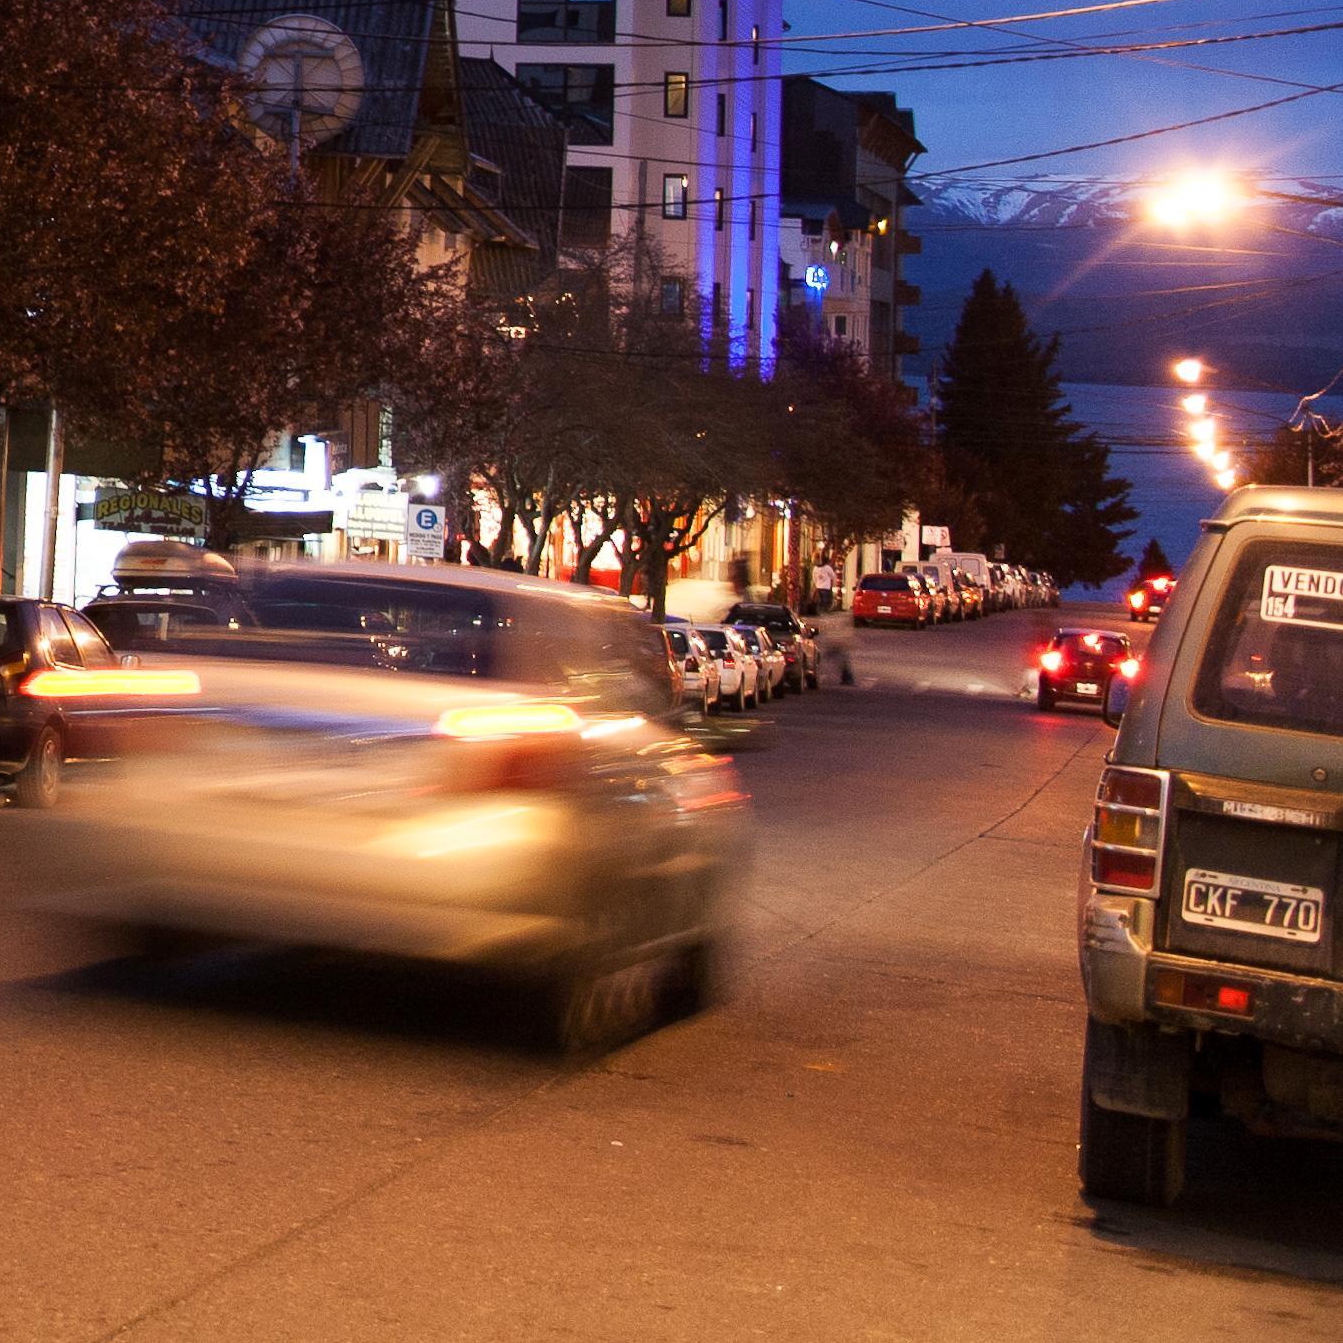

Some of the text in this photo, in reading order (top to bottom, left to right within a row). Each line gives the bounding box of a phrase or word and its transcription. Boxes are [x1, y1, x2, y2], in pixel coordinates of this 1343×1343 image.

[97, 491, 204, 526] REGIONALES
[1266, 594, 1296, 618] 154
[1189, 883, 1315, 931] CKF 770
